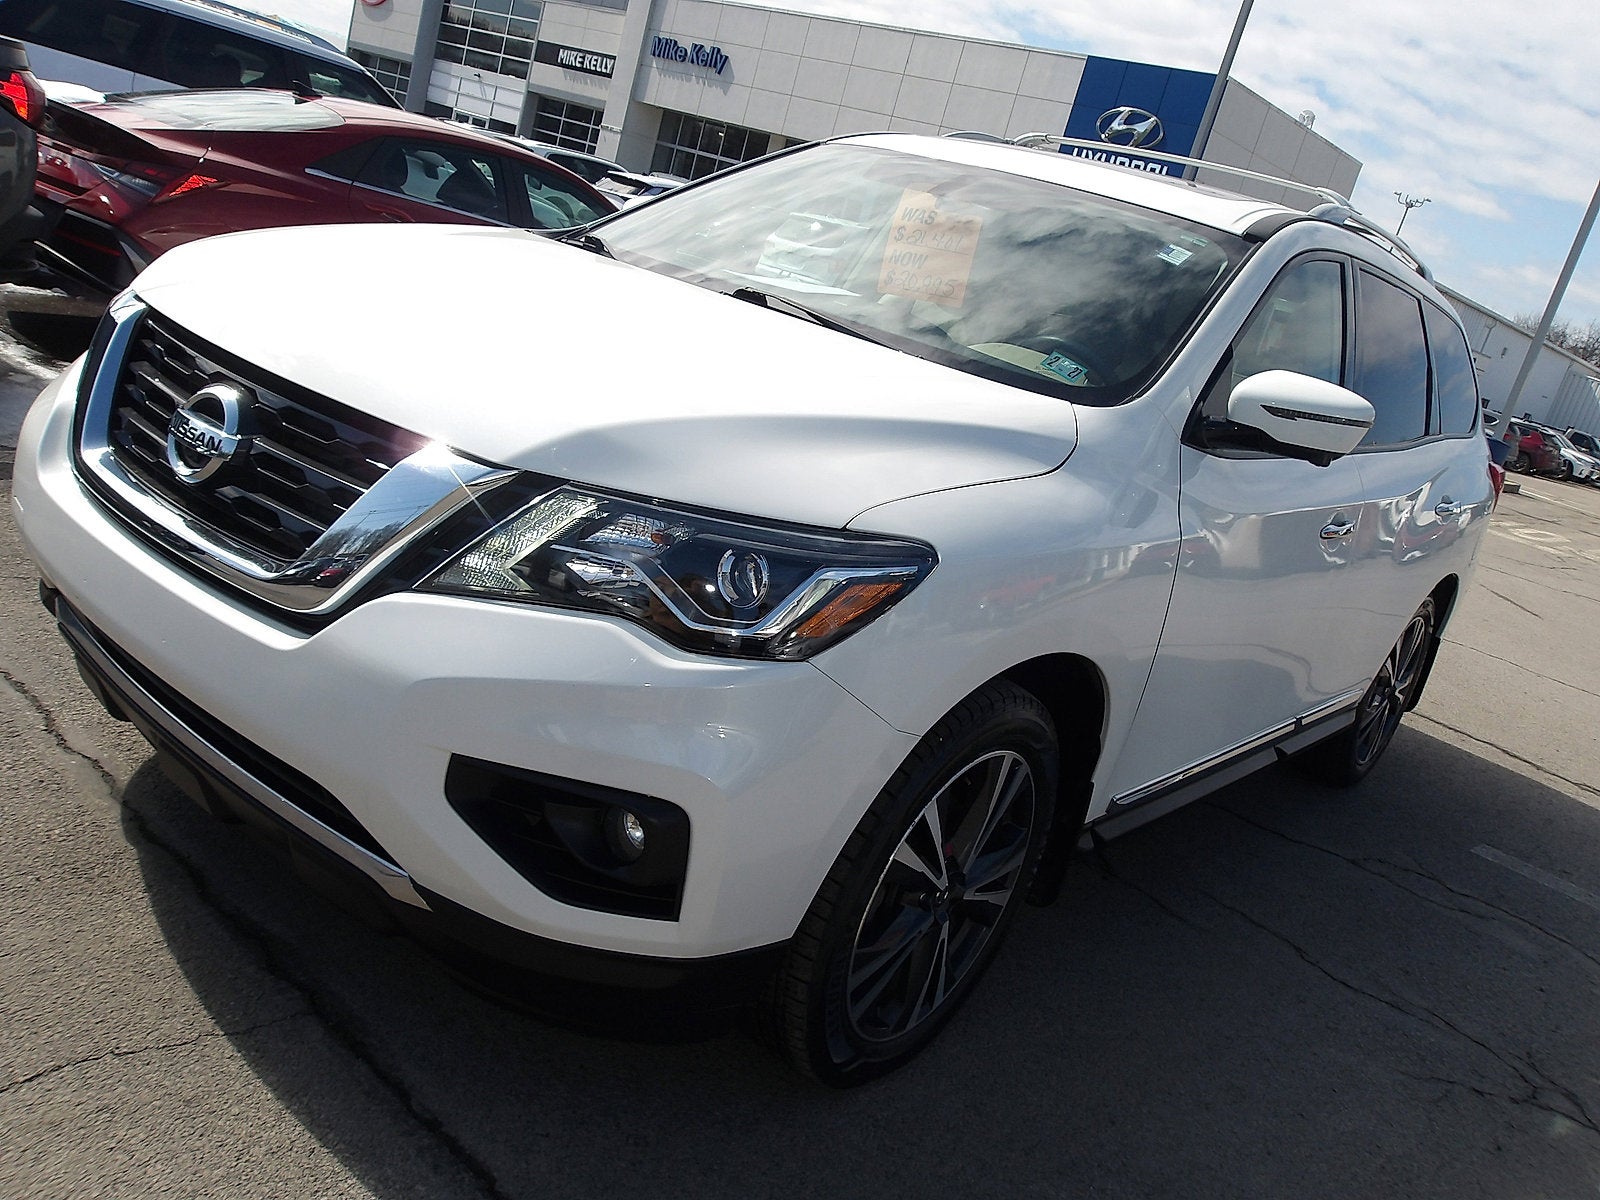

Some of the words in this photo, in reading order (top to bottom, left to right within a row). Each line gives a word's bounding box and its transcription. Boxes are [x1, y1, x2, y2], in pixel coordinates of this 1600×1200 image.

[557, 49, 583, 68] MIKE
[583, 53, 615, 74] KELLY
[651, 36, 687, 62] Mike
[688, 43, 730, 75] Kelly
[901, 207, 938, 225] WAS
[889, 251, 929, 269] NOW
[173, 417, 223, 453] NISSAN
